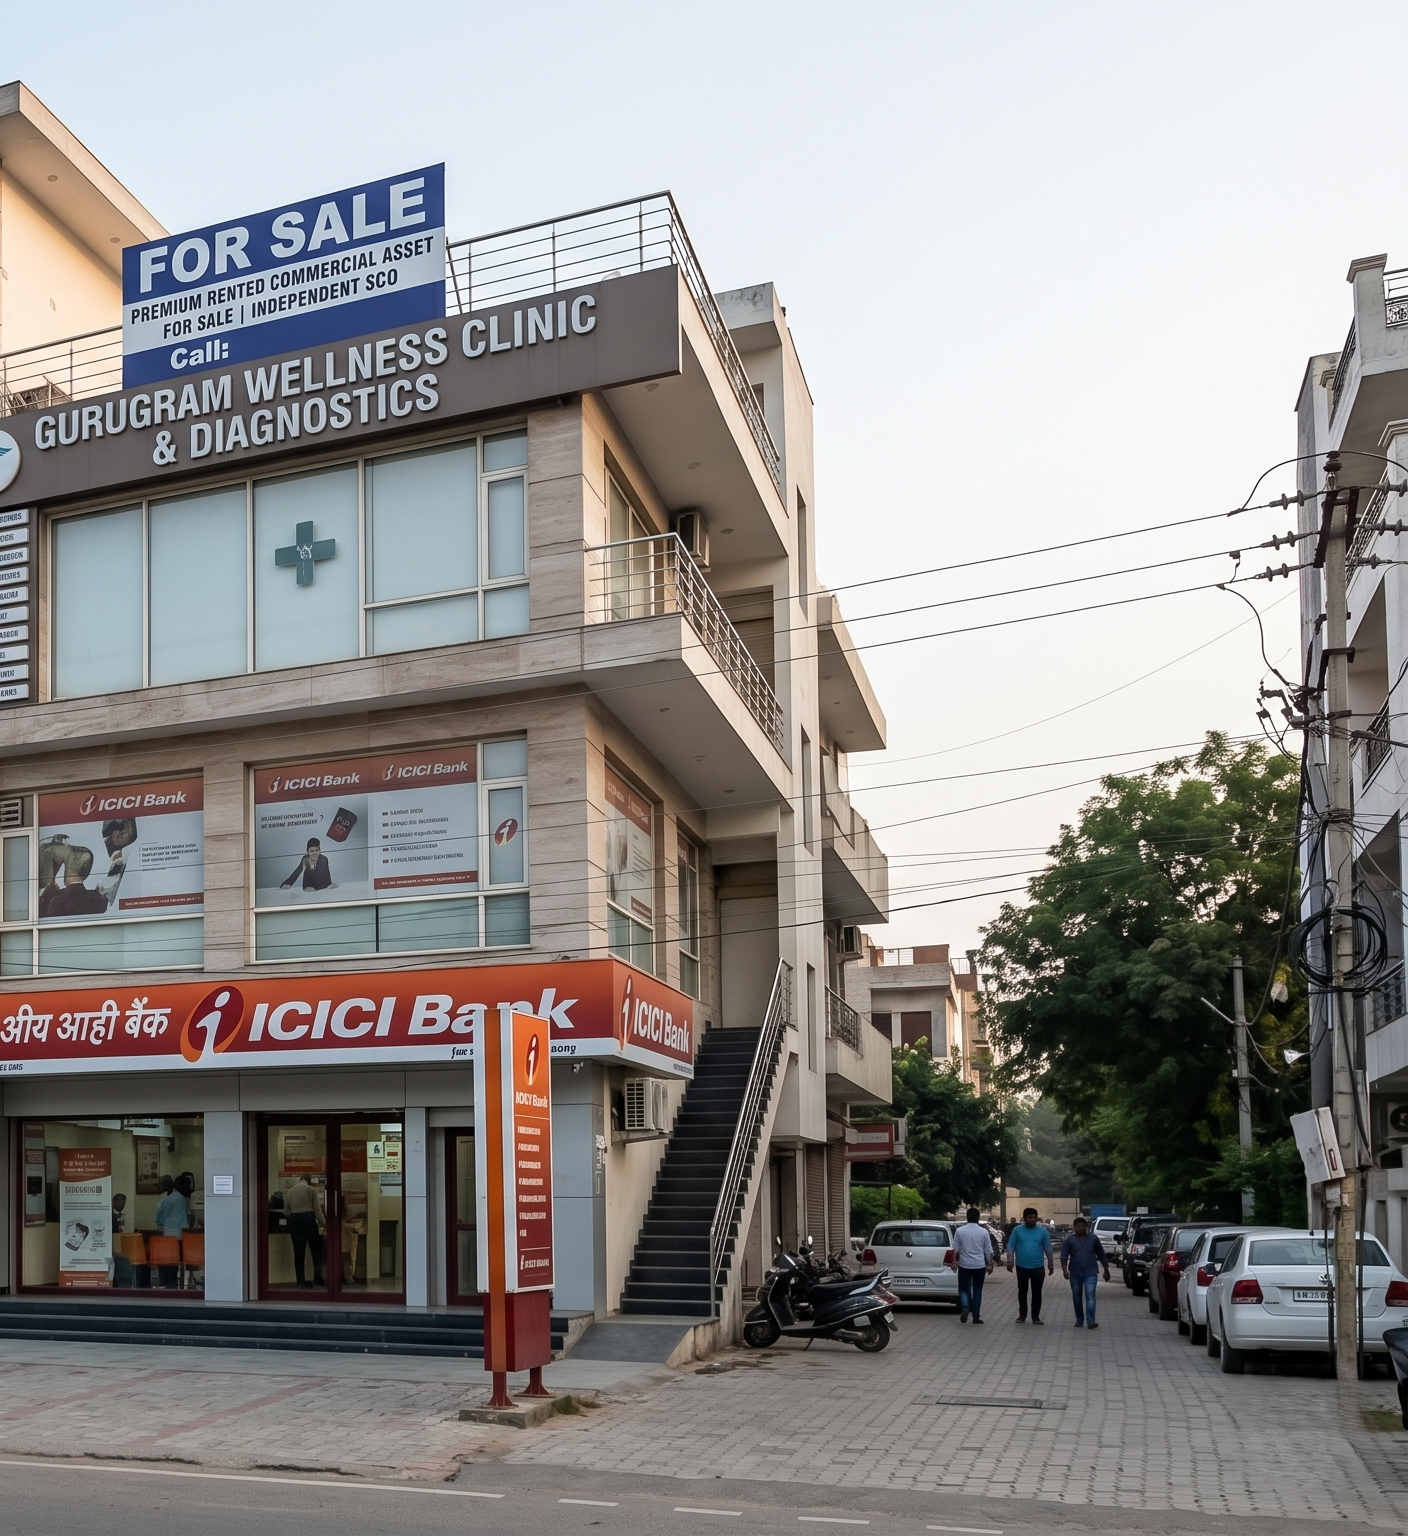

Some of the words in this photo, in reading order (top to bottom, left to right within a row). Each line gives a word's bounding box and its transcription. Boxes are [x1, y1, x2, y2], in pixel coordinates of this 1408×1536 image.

[139, 225, 252, 294] FOR
[269, 176, 426, 259] SALE
[130, 293, 203, 325] PREMIUM
[206, 278, 265, 307] RENTED
[269, 251, 377, 292] COMMERCIAL
[381, 235, 434, 265] ASSET
[162, 319, 192, 340] FOR
[196, 307, 234, 332] SALE
[251, 277, 361, 319] INDEPENDENT
[365, 268, 399, 292] SCO
[34, 374, 232, 450] GURUGRAM
[244, 327, 449, 401] WELLNESS
[461, 294, 597, 358] CLINIC
[169, 338, 229, 370] Call:
[152, 429, 177, 466] &
[190, 373, 440, 460] DIAGNOSTICS
[283, 776, 321, 791] ICICI
[322, 772, 360, 787] Bank
[397, 764, 432, 779] ICICI
[433, 760, 468, 775] Bank
[98, 795, 142, 812] ICICI
[143, 790, 187, 807] Bank
[56, 999, 121, 1046] आही
[124, 996, 172, 1038] बैंक
[248, 996, 396, 1042] ICICI
[633, 998, 664, 1044] ICICI
[664, 1019, 690, 1054] Bank
